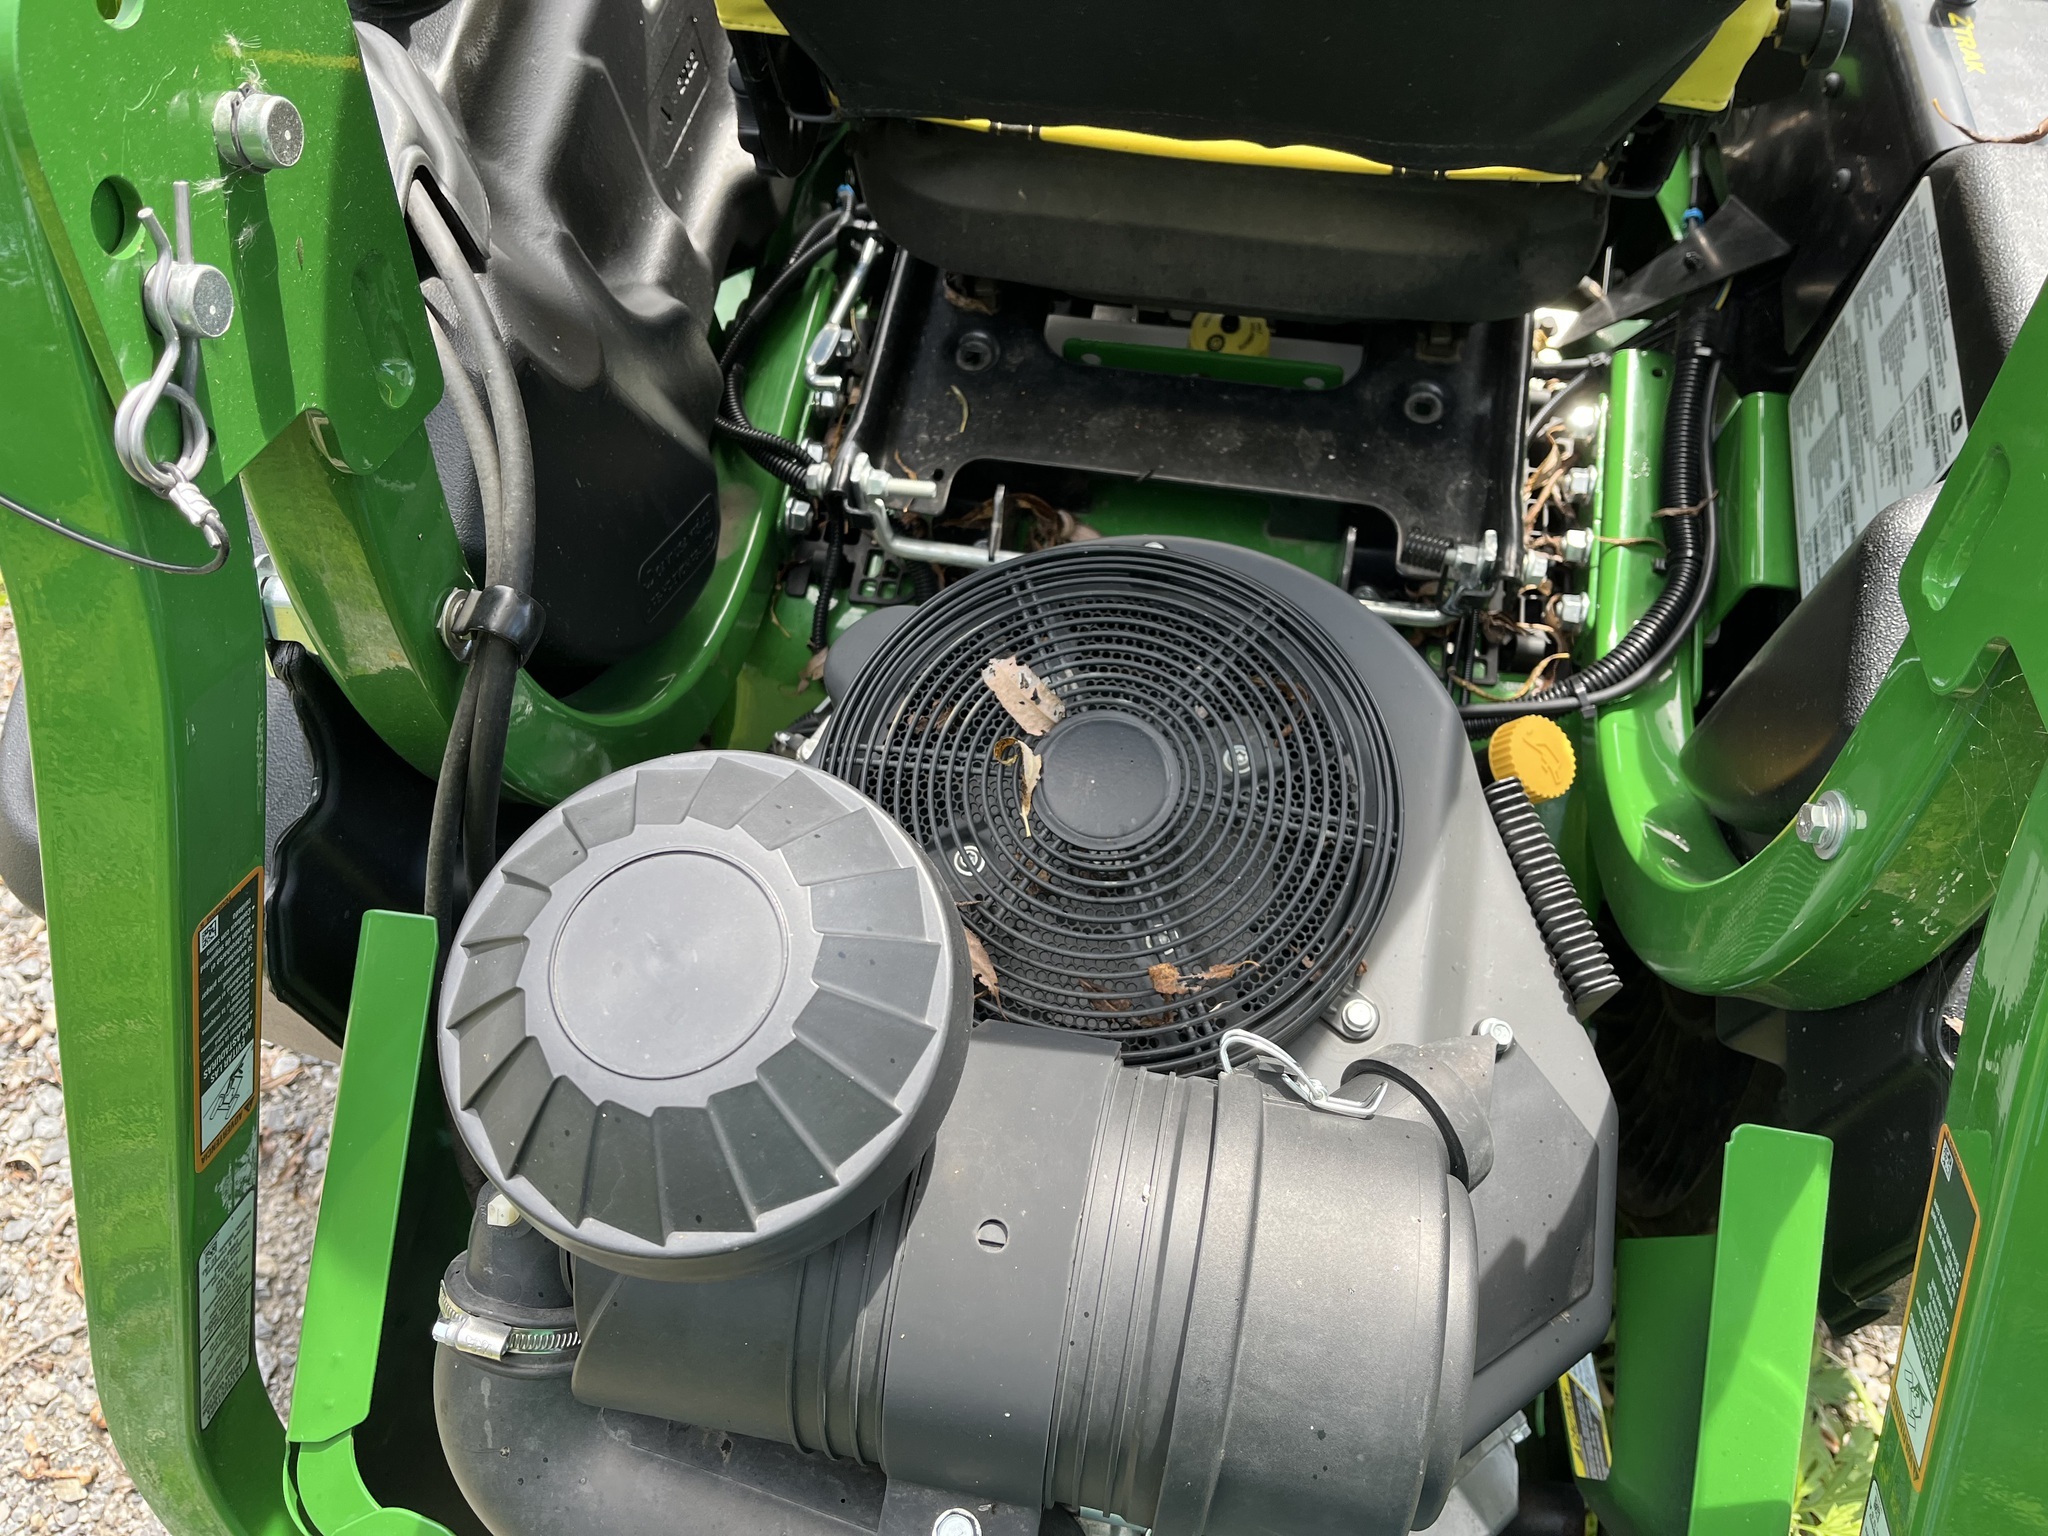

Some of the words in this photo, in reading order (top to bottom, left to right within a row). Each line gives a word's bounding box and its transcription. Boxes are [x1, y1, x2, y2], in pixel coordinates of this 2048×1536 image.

[203, 1018, 251, 1080] APLASTADURAS
[223, 1037, 245, 1068] EVITAR
[210, 1064, 221, 1084] LAS
[200, 1109, 244, 1165] ADVERTENCIA
